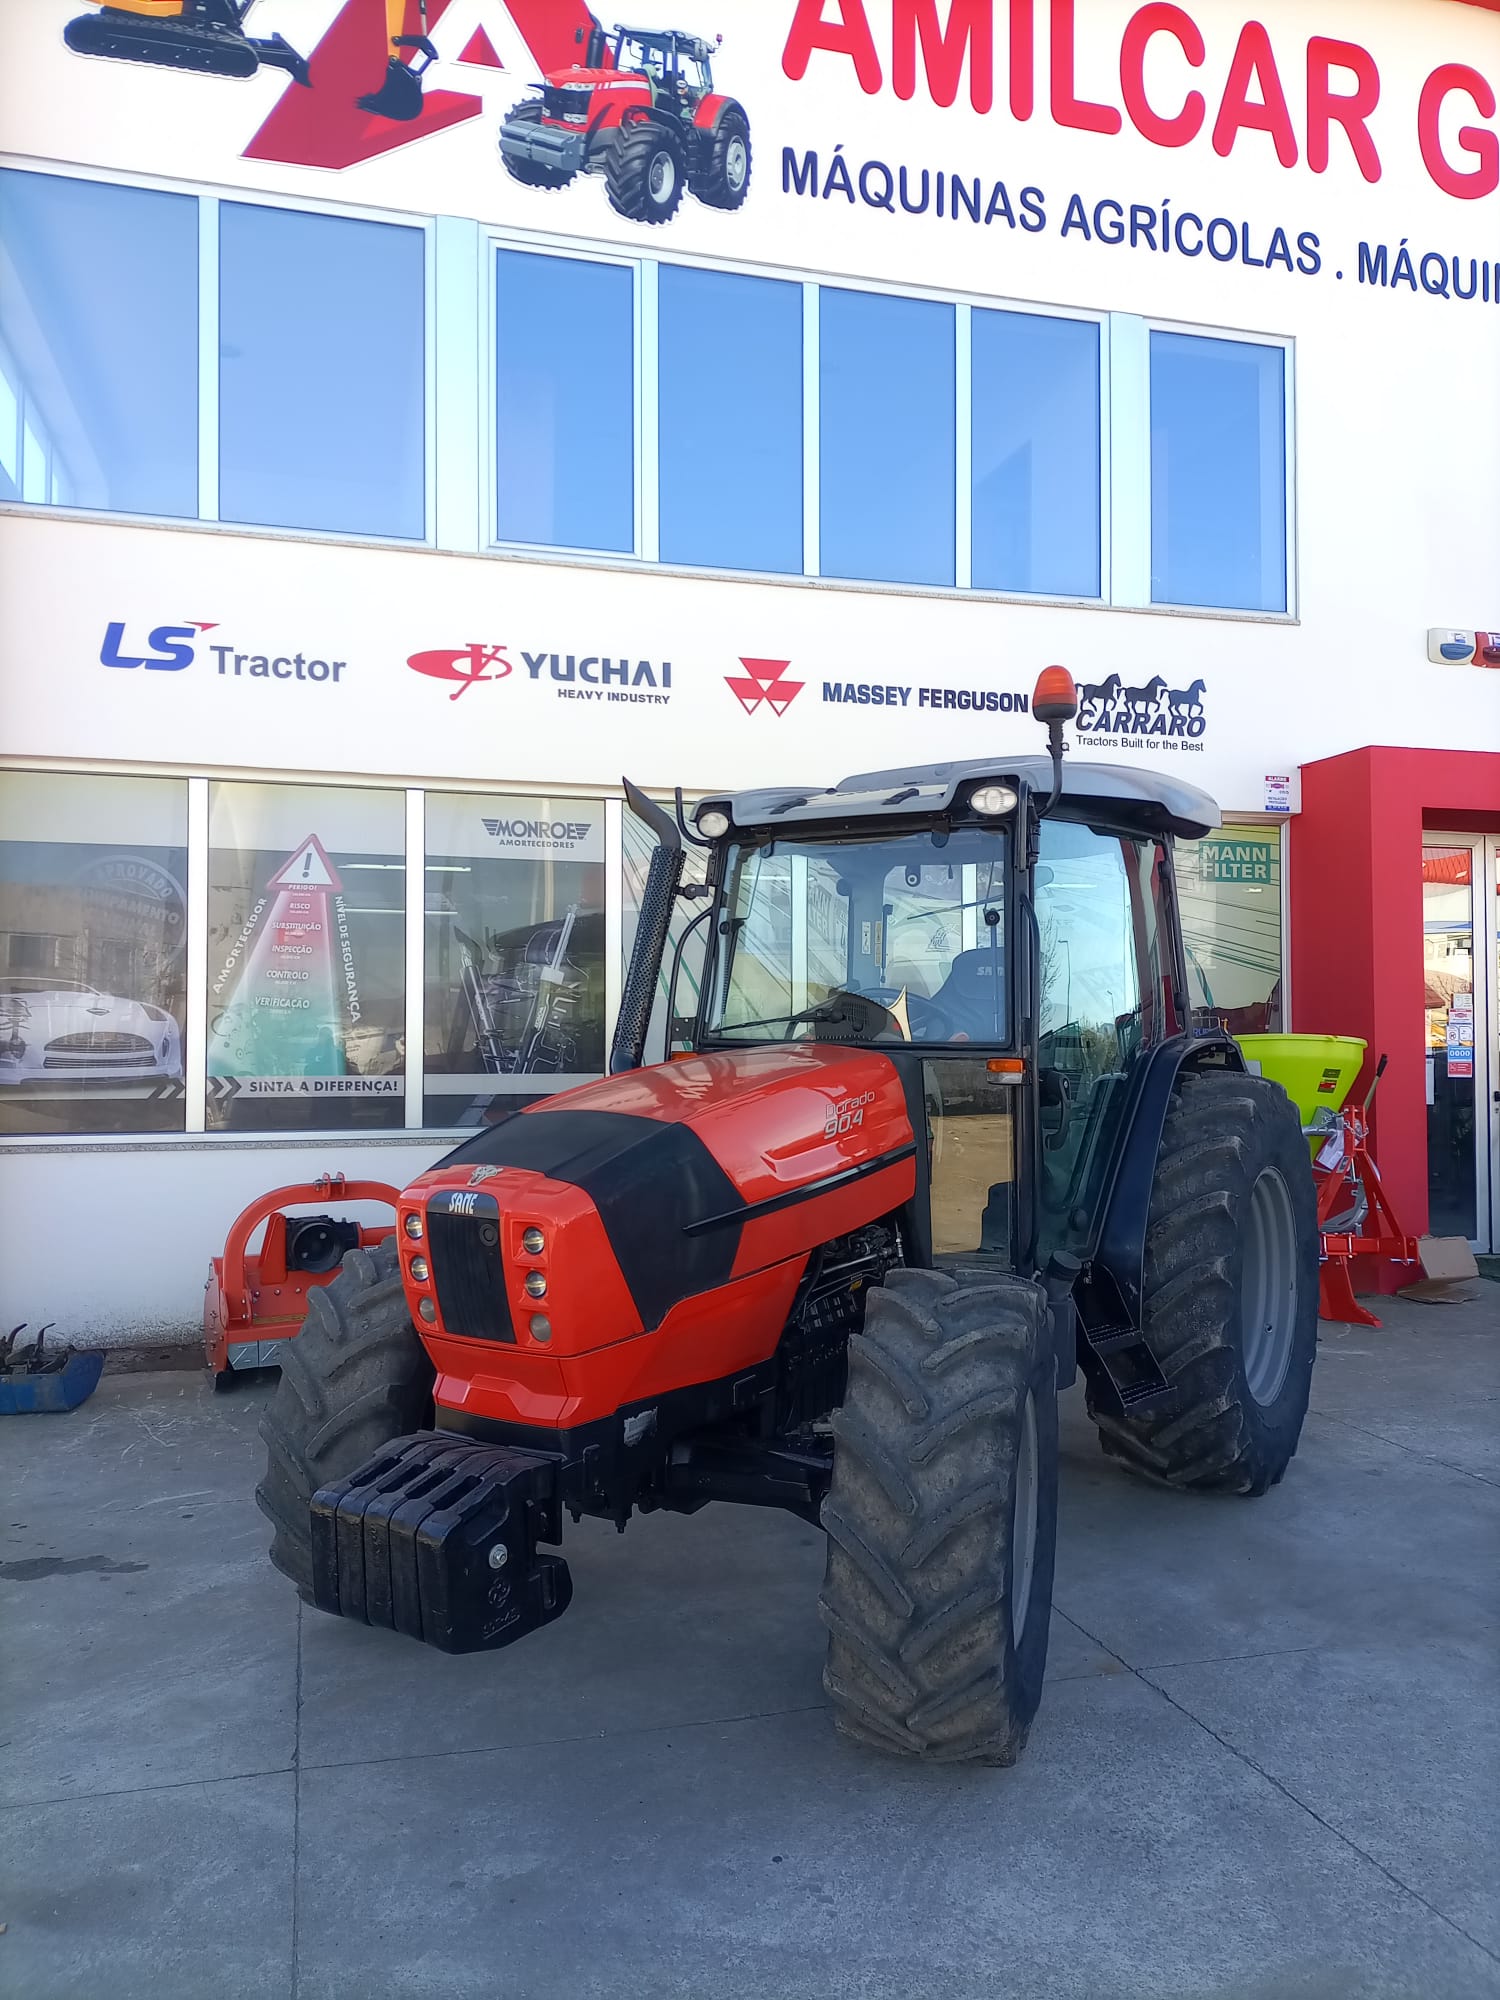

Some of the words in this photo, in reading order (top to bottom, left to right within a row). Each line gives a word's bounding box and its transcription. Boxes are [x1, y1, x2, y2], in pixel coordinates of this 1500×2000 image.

[781, 0, 1382, 184] AMILCAR
[782, 144, 1047, 232] MÁQUINAS
[1061, 199, 1321, 275] AGRÍCOLAS
[99, 621, 196, 672] LS
[209, 645, 347, 682] Tractor
[519, 651, 672, 688] YUCHAI
[557, 688, 604, 701] HEAVY
[607, 691, 671, 705] INDUSTRY
[822, 681, 912, 707] MASSEY
[918, 687, 1029, 713] FERGUSON
[1075, 708, 1207, 738] CARRARO
[1076, 734, 1118, 747] Tractors
[1121, 737, 1144, 748] Built
[1146, 739, 1161, 750] for
[1162, 740, 1179, 750] the
[1181, 740, 1204, 752] Best
[496, 818, 578, 841] MONROE
[499, 838, 575, 849] AMORTECEDORES
[1202, 845, 1267, 862] MANN
[1202, 862, 1267, 879] FILTER
[289, 902, 311, 910] RISCO
[335, 896, 347, 924] NÍVEL
[271, 920, 322, 932] SUBSTITUIÇÃO
[339, 925, 349, 939] DE
[212, 898, 267, 994] AMORTECEDOR
[271, 945, 313, 955] INSPECÇÃO
[266, 970, 309, 980] CONTROLO
[341, 940, 362, 1023] SEGURANÇA
[249, 1081, 295, 1093] SINTA
[299, 1081, 309, 1092] A
[314, 1080, 398, 1095] DIFERENÇA!
[825, 1090, 876, 1119] Dorado
[823, 1108, 864, 1140] 90.4
[448, 1192, 479, 1215] SAME
